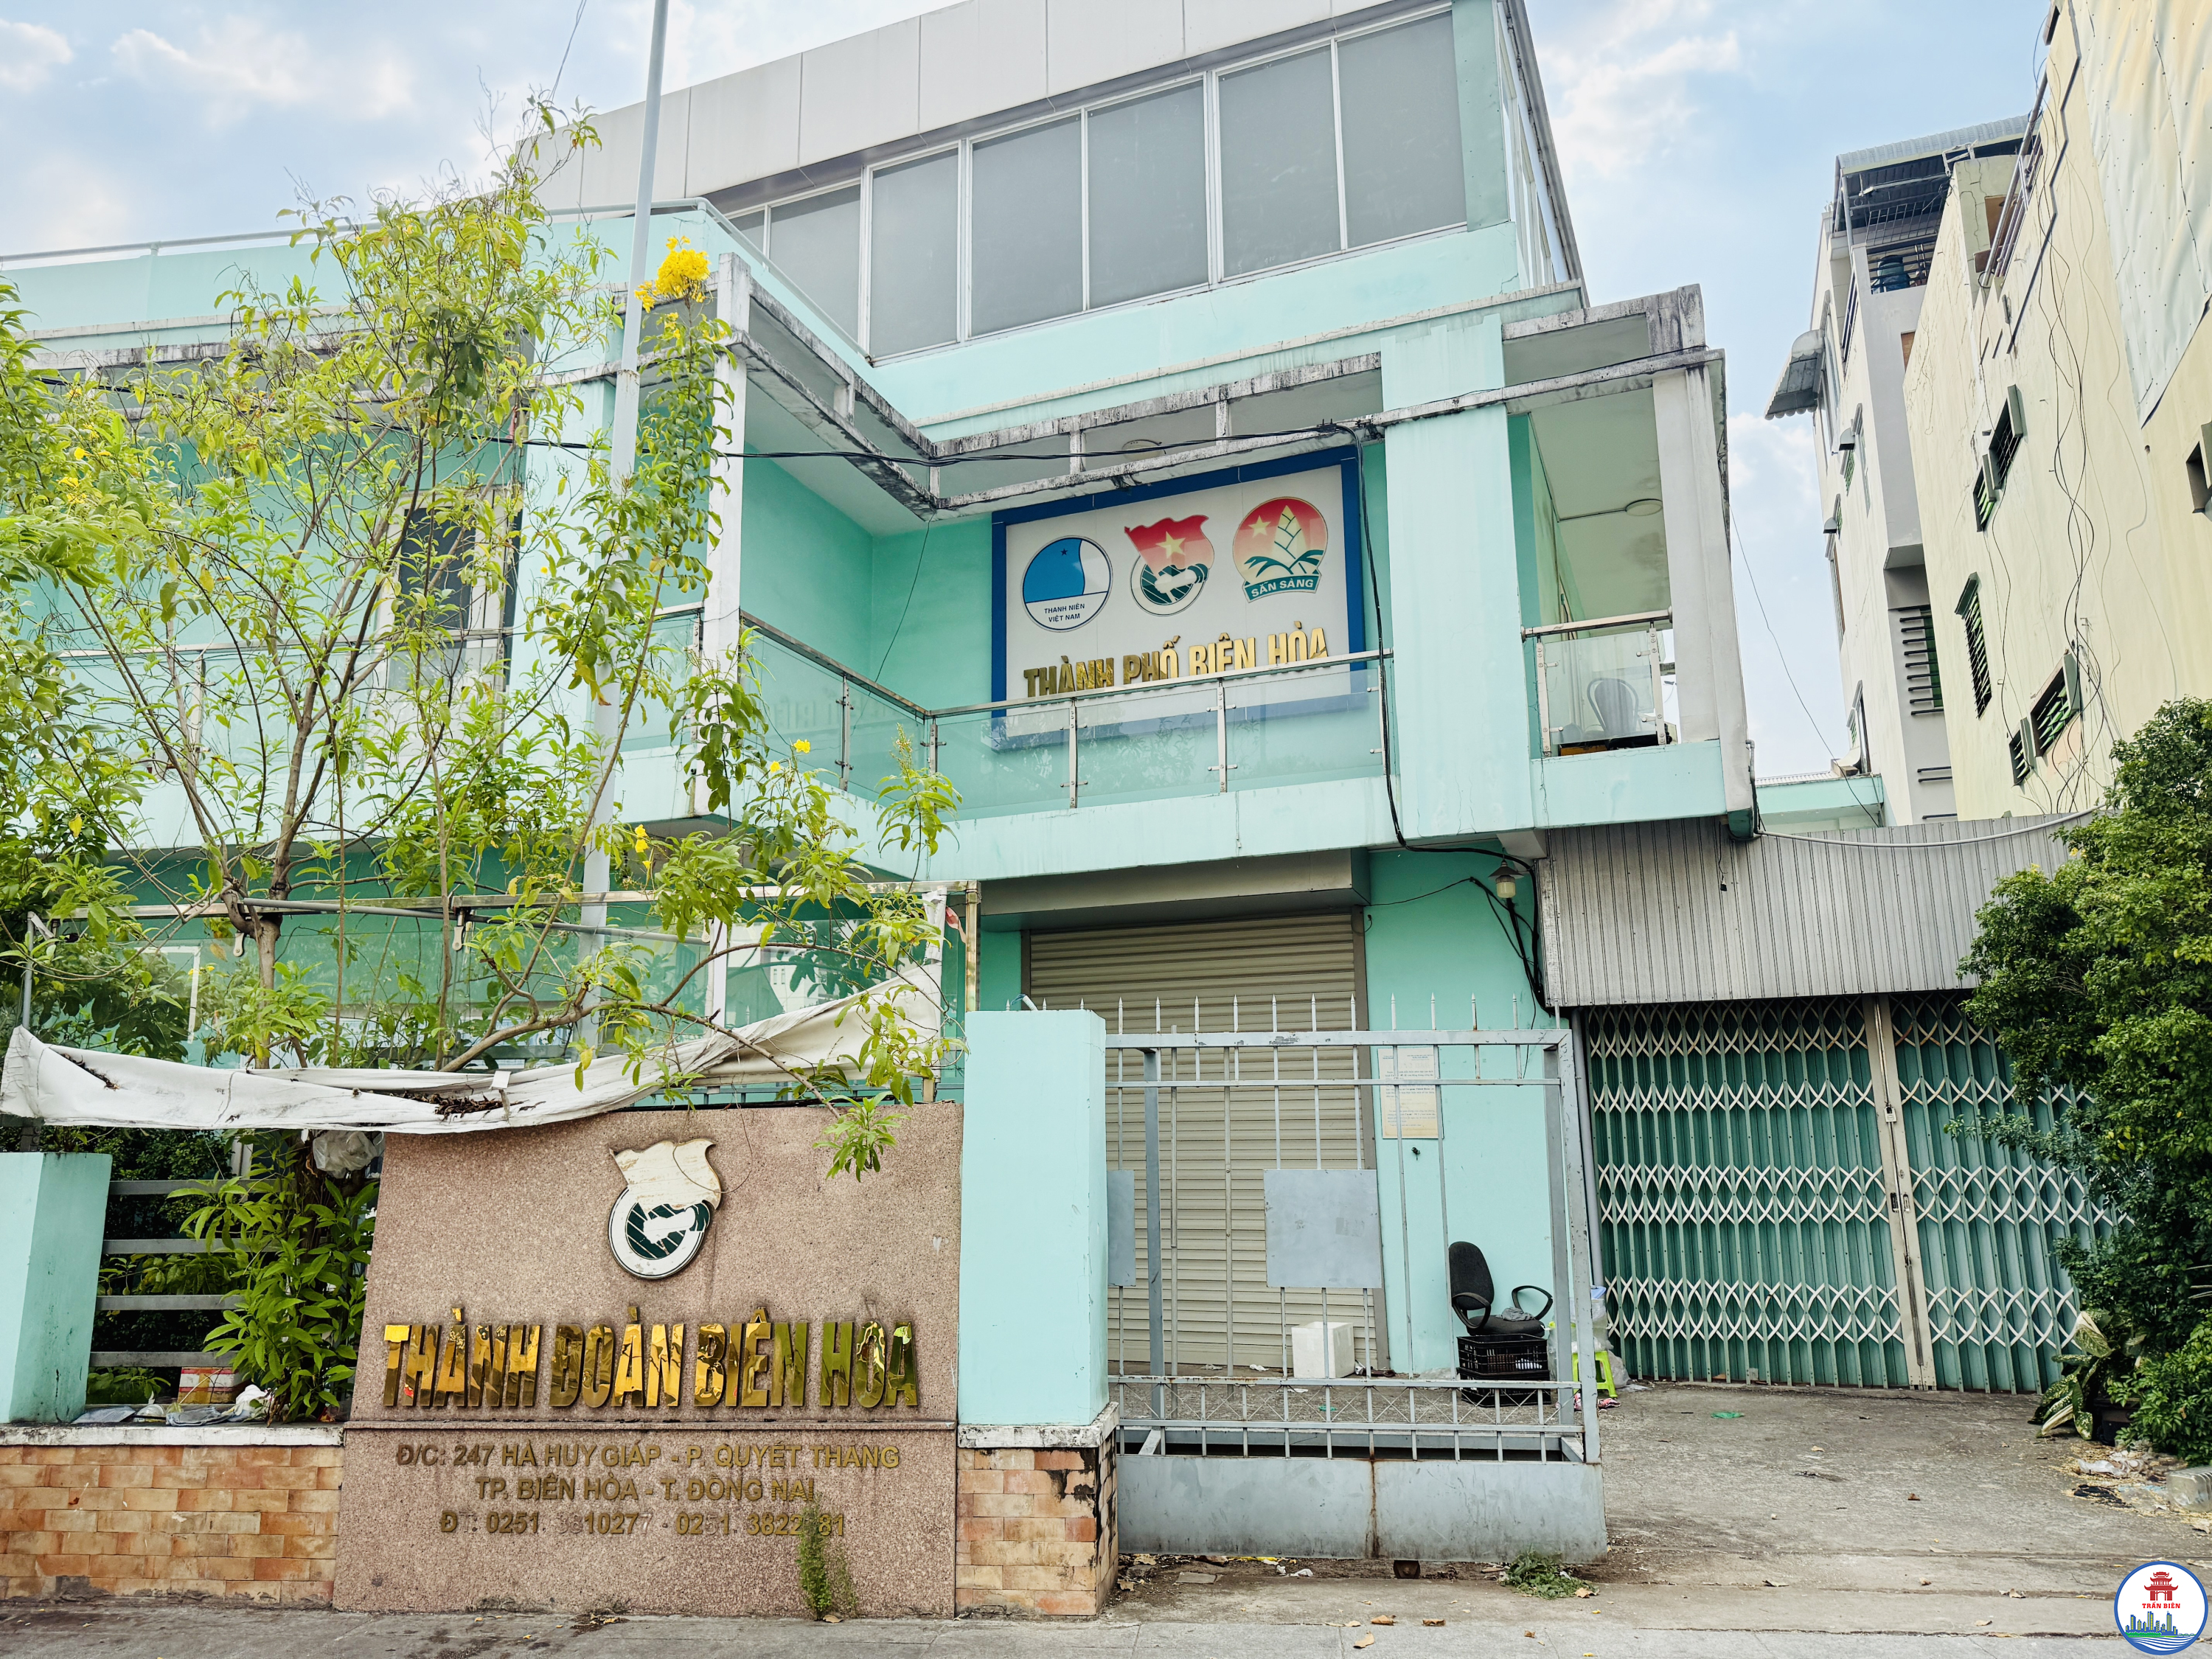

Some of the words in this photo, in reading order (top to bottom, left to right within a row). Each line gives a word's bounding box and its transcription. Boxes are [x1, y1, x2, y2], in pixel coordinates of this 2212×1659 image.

[1251, 581, 1277, 597] SẴN
[1279, 578, 1314, 589] SÀNG
[1044, 605, 1067, 614] THANH
[1068, 603, 1085, 611] NIÊN
[1065, 613, 1080, 621] NAM
[1023, 655, 1114, 698] THÀNH
[1123, 635, 1180, 684] PHỐ
[1189, 632, 1256, 675] BIÊN
[1267, 620, 1328, 665] HÒA
[383, 1306, 543, 1407] THÀNH
[549, 1306, 684, 1408] ĐOÀN
[694, 1307, 811, 1407] BIÊN
[396, 1444, 445, 1467] Đ/C:
[453, 1444, 495, 1467] 247
[544, 1444, 597, 1467] HUY
[601, 1439, 661, 1467] GIÁP
[686, 1444, 706, 1467] P.
[475, 1476, 509, 1500] TP.
[518, 1472, 575, 1500] BIÊN
[583, 1472, 639, 1500] HÒA
[661, 1478, 678, 1500] T.
[771, 1478, 815, 1501] NAI
[746, 1512, 844, 1536] 382281
